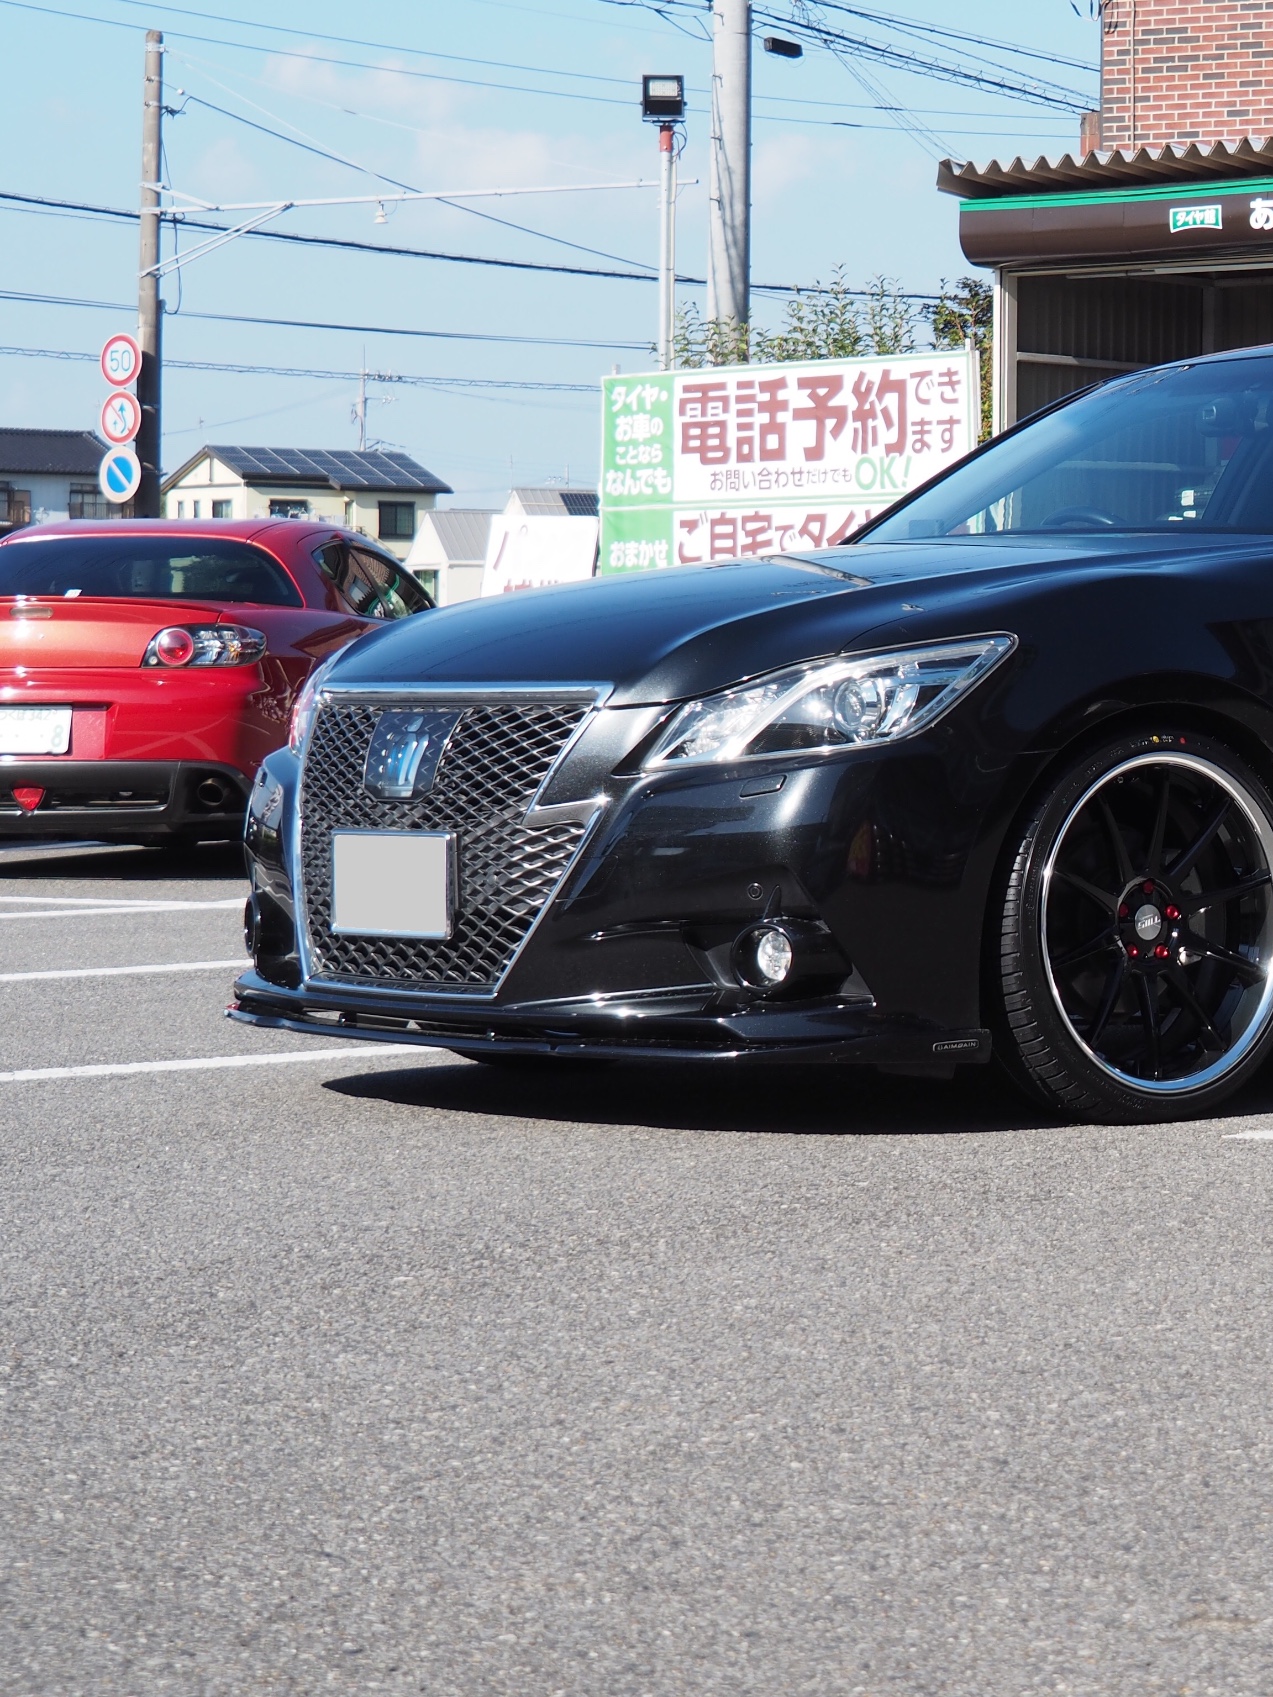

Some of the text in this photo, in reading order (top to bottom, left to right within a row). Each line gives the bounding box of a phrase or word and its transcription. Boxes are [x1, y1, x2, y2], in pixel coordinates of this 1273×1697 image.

[1174, 207, 1217, 227] タイヤ館
[109, 349, 132, 374] 50
[613, 416, 664, 441] お車の
[678, 367, 908, 466] 電話予約
[615, 444, 664, 466] ことなら
[605, 467, 672, 497] なんでも
[709, 454, 913, 492] お問い合わせだけでも OK!
[678, 509, 874, 565] ご自宅でタイ
[608, 539, 669, 568] おまかせ
